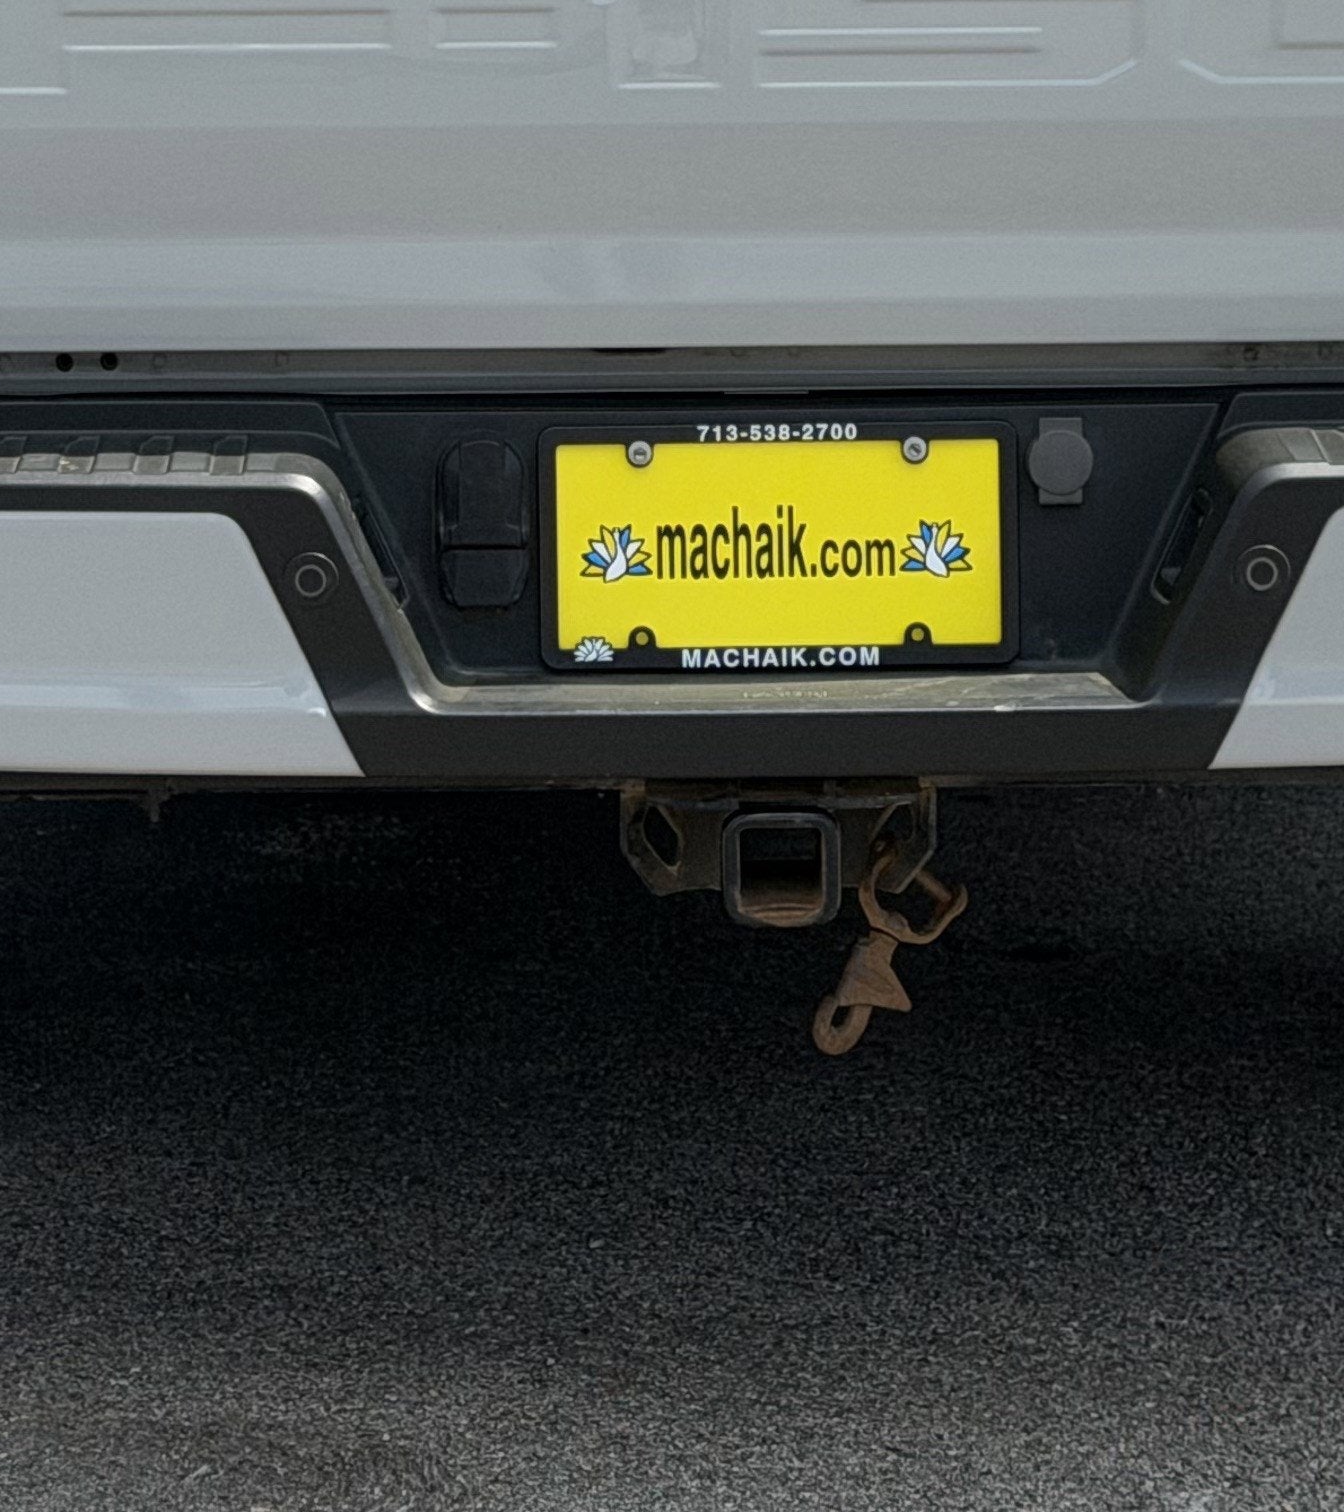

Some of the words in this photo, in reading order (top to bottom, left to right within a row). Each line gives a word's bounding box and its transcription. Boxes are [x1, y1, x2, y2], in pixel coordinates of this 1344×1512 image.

[696, 423, 858, 443] 713-538-2700
[655, 504, 897, 580] machaik.com
[681, 646, 881, 670] MACHAIK.COM
